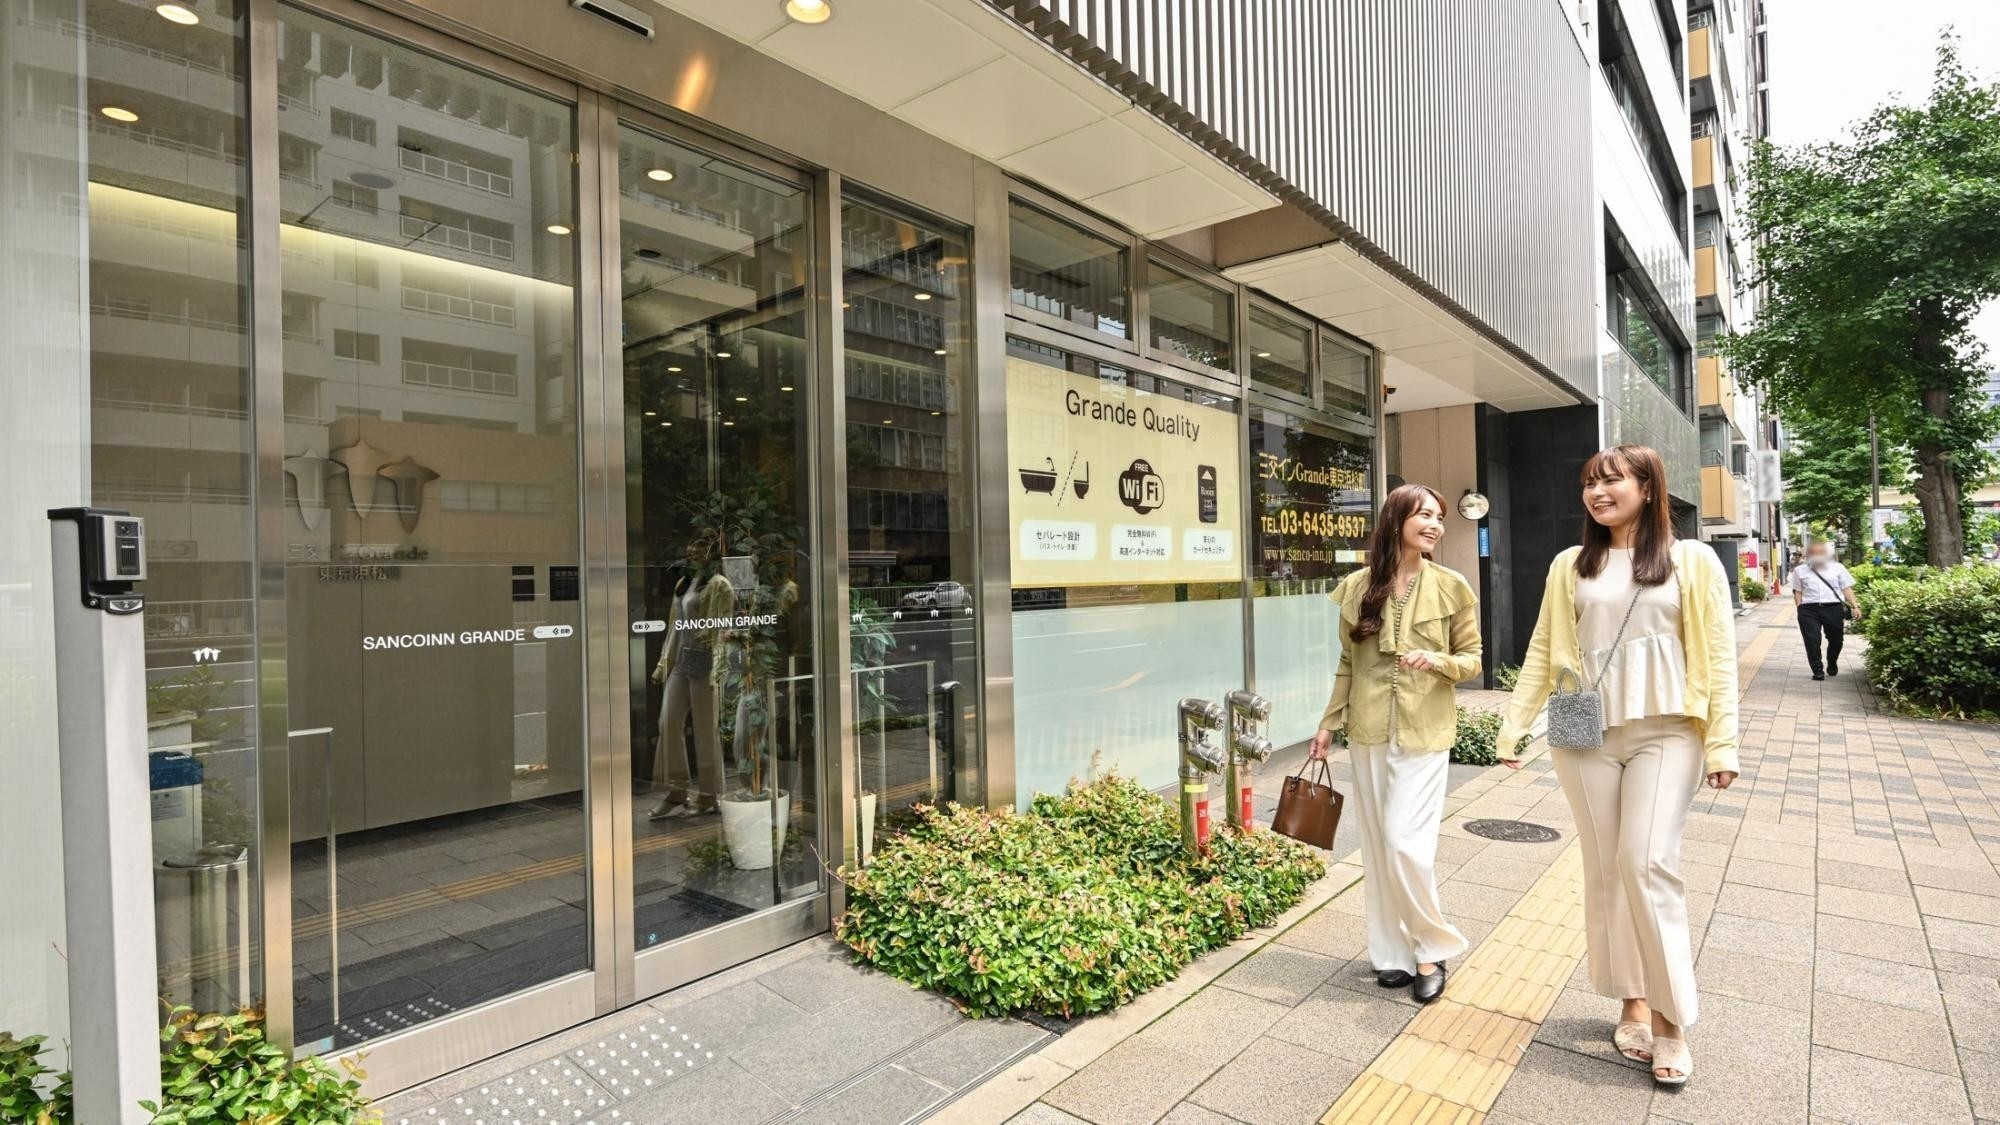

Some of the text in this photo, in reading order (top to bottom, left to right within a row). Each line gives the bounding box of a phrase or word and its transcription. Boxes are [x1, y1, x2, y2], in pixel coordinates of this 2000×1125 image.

[1065, 389, 1200, 442] Grande Quality
[1134, 463, 1149, 472] FREE
[1036, 529, 1080, 542] セパレート設計
[1264, 546, 1333, 564] www.sanco-inn.jp
[674, 614, 777, 630] SANCOINN GRANDE
[362, 629, 525, 651] SANCOINN GRANDE
